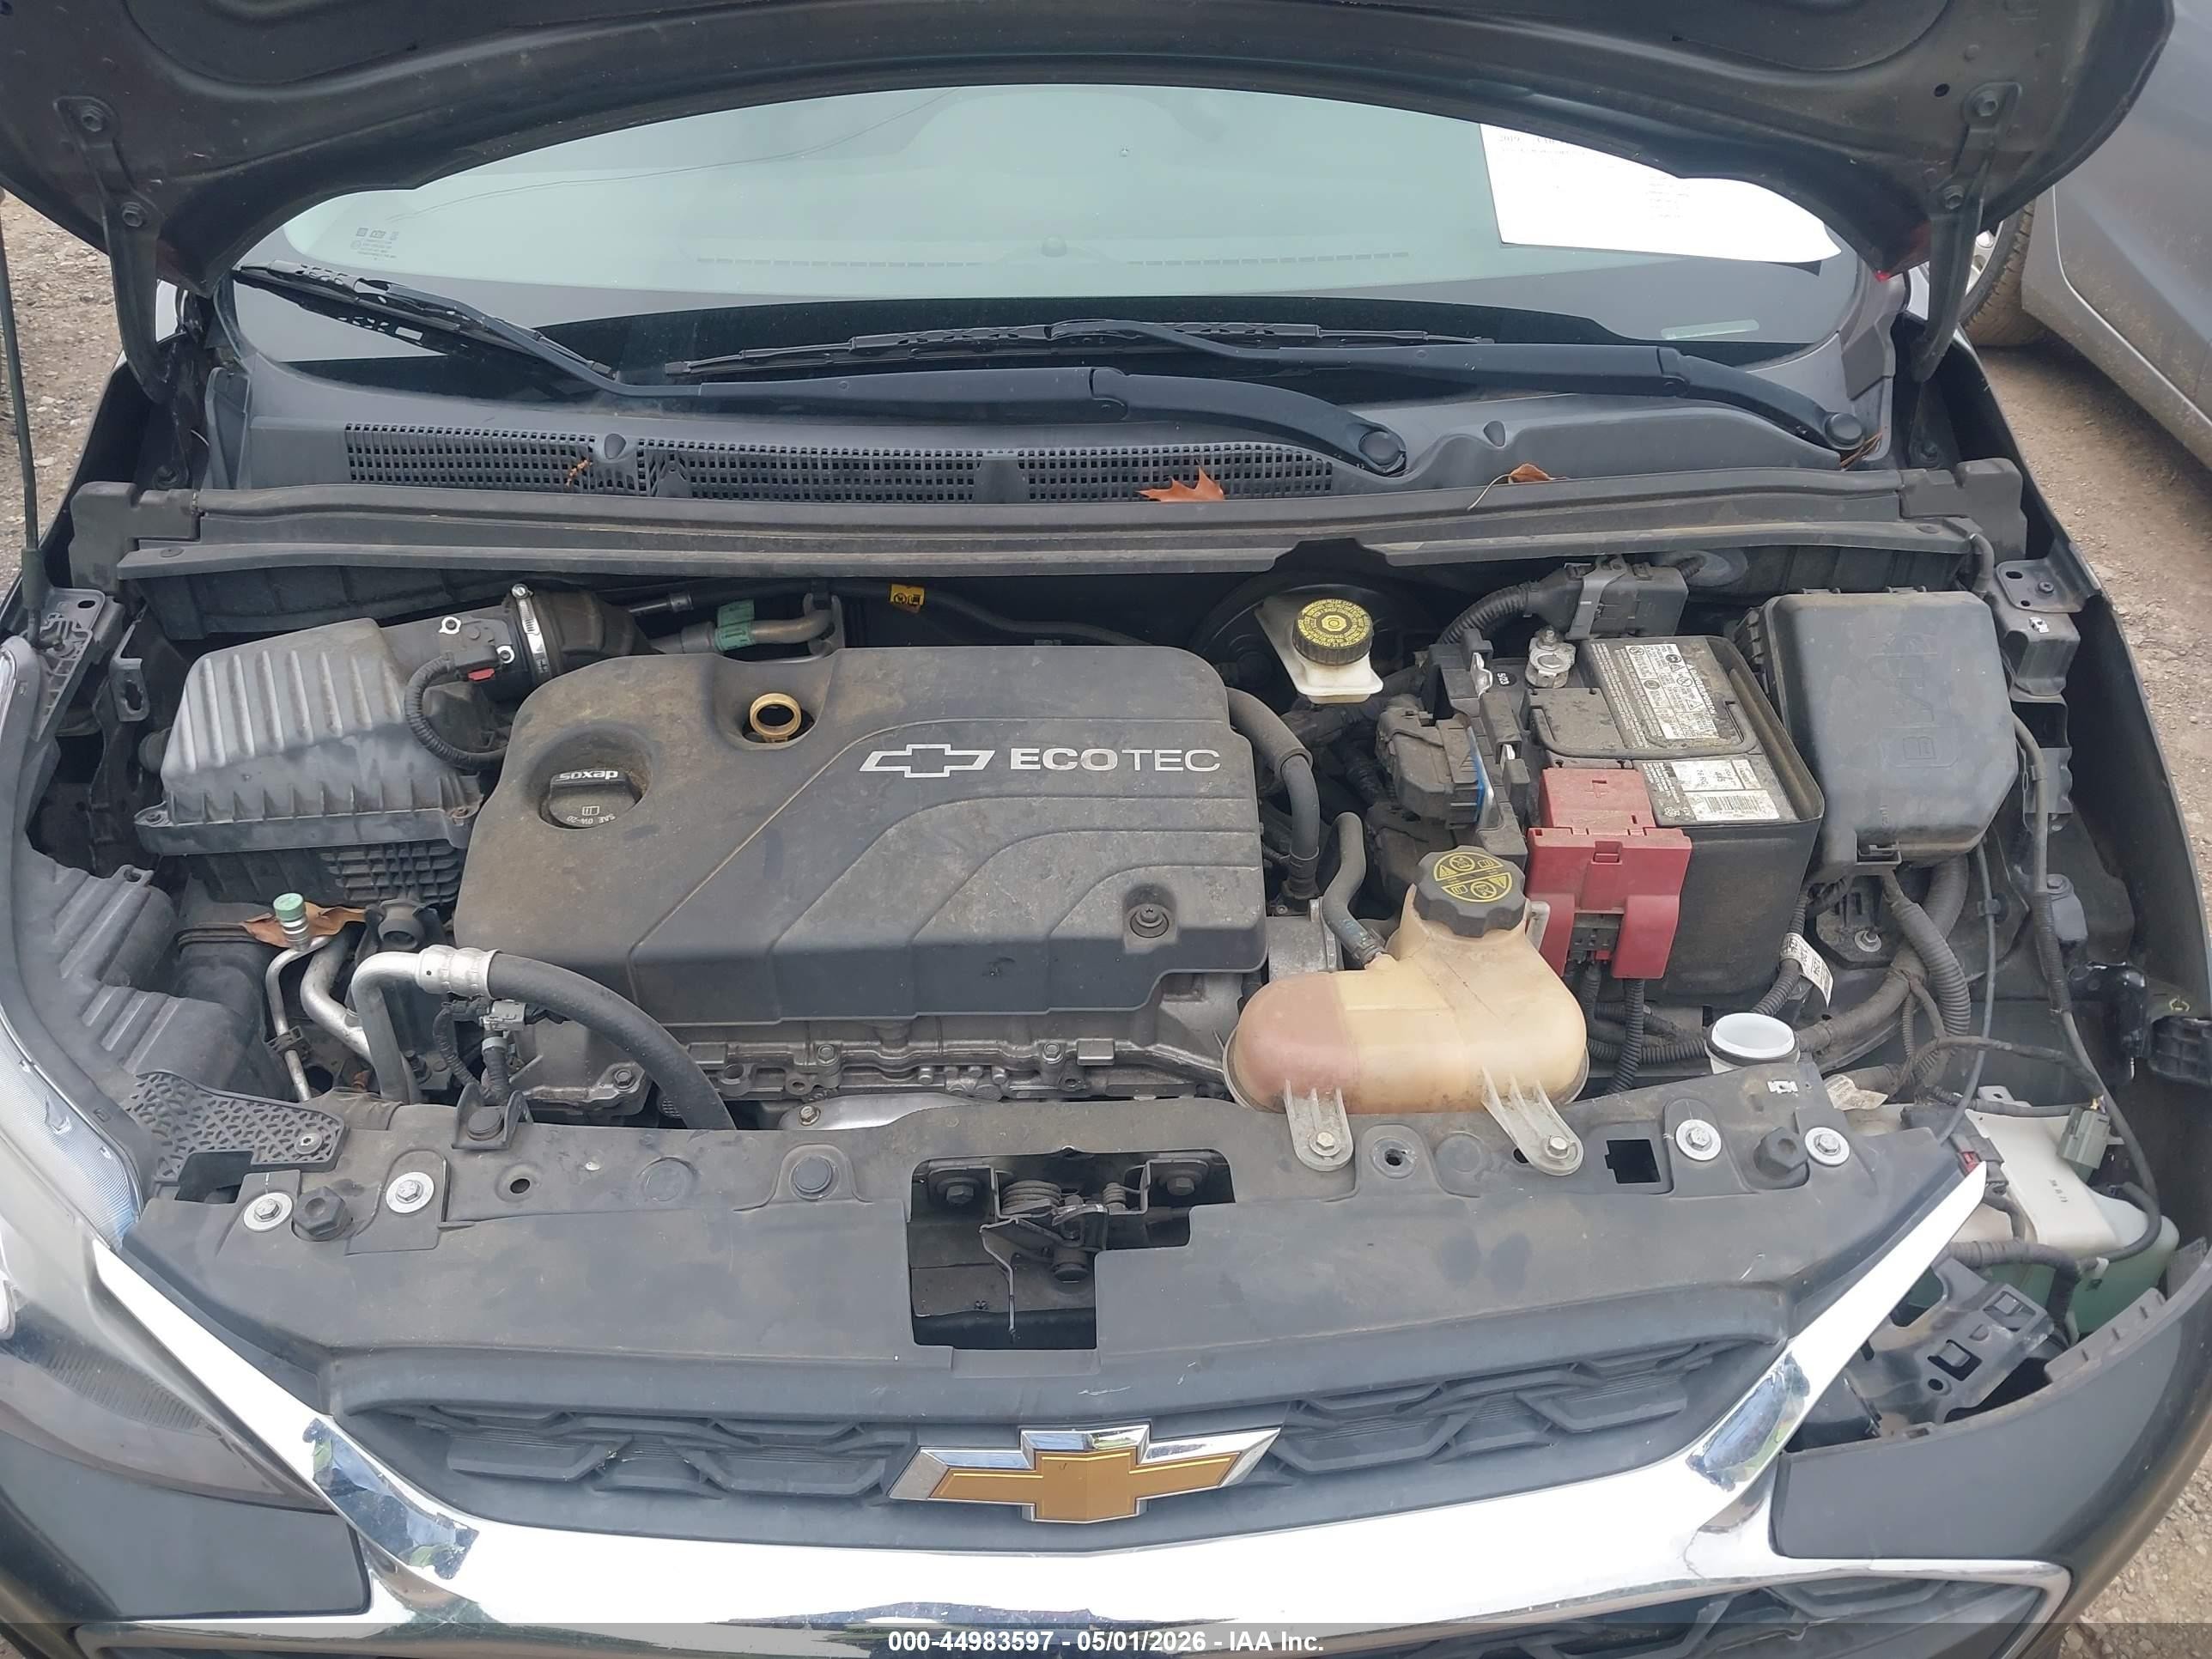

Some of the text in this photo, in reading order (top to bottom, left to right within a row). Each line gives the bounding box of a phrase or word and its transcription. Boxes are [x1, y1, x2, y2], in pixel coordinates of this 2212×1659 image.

[1010, 748, 1221, 772] ECOTEC
[556, 770, 619, 781] dexos
[566, 813, 617, 824] SAE 0W-20
